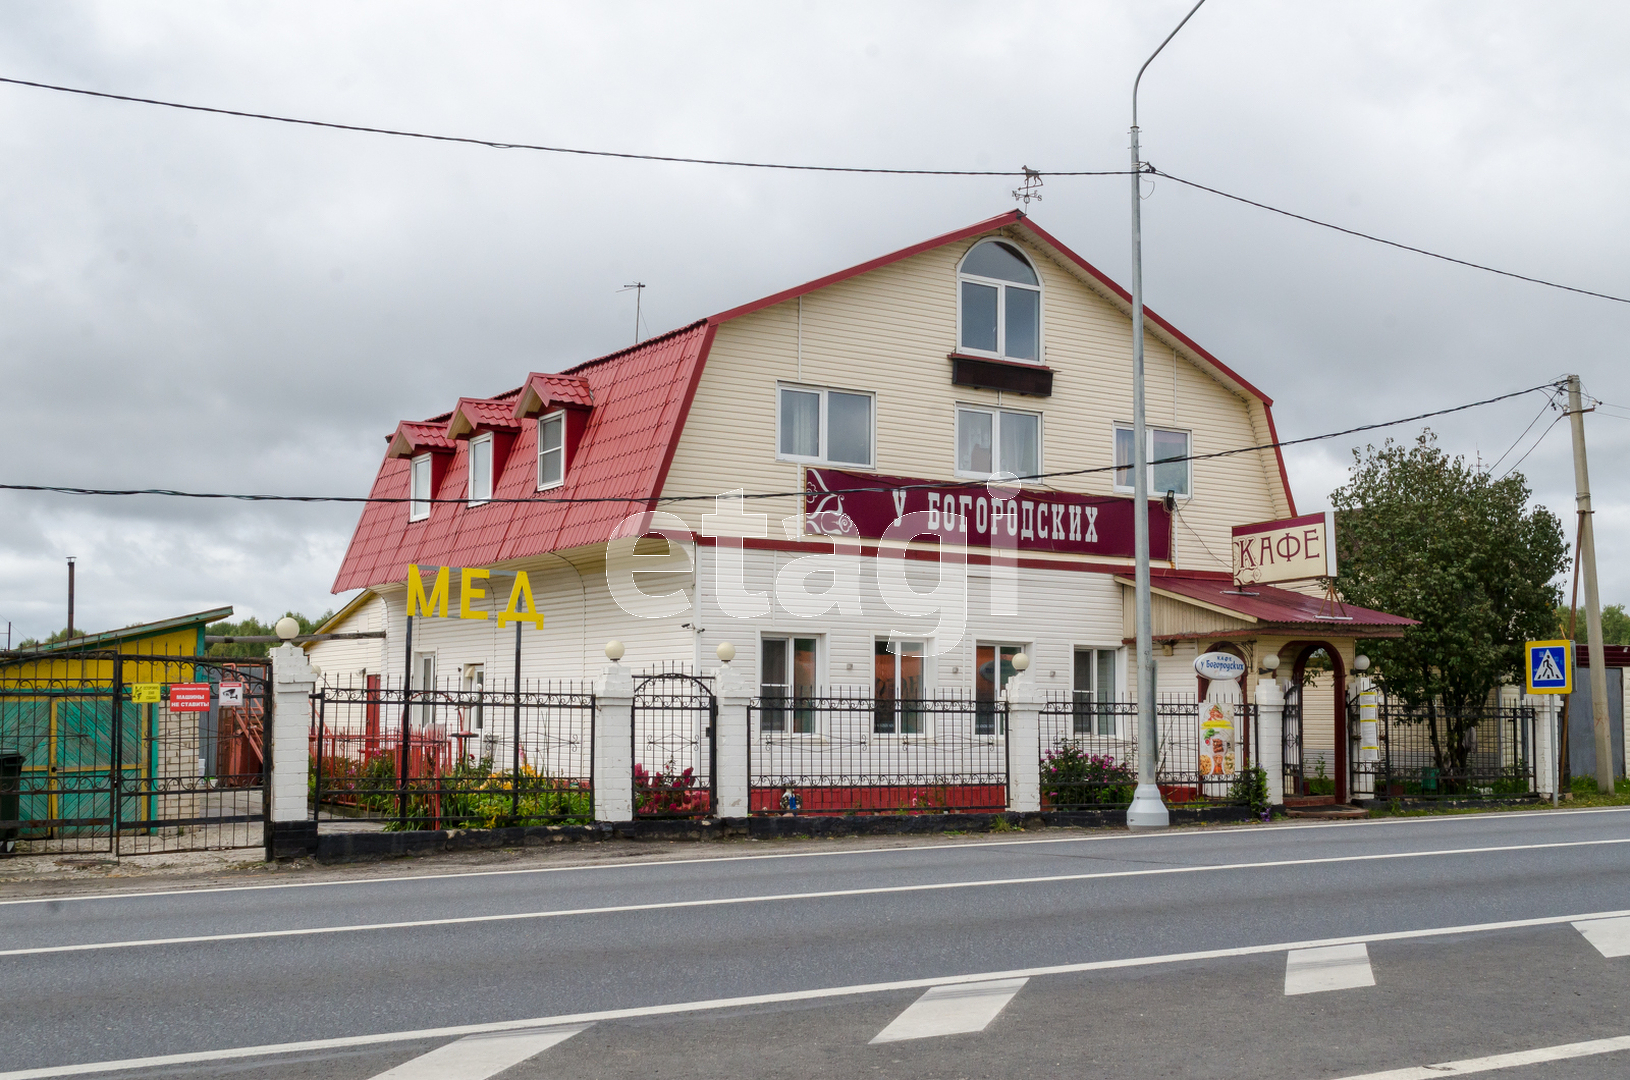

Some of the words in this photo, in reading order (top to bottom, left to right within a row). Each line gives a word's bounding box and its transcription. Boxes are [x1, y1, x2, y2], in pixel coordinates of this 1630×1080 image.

[892, 489, 907, 528] У
[927, 491, 1099, 543] БОГОРОДСКИХ
[1239, 528, 1320, 569] КАФЕ
[406, 564, 544, 630] МЕД
